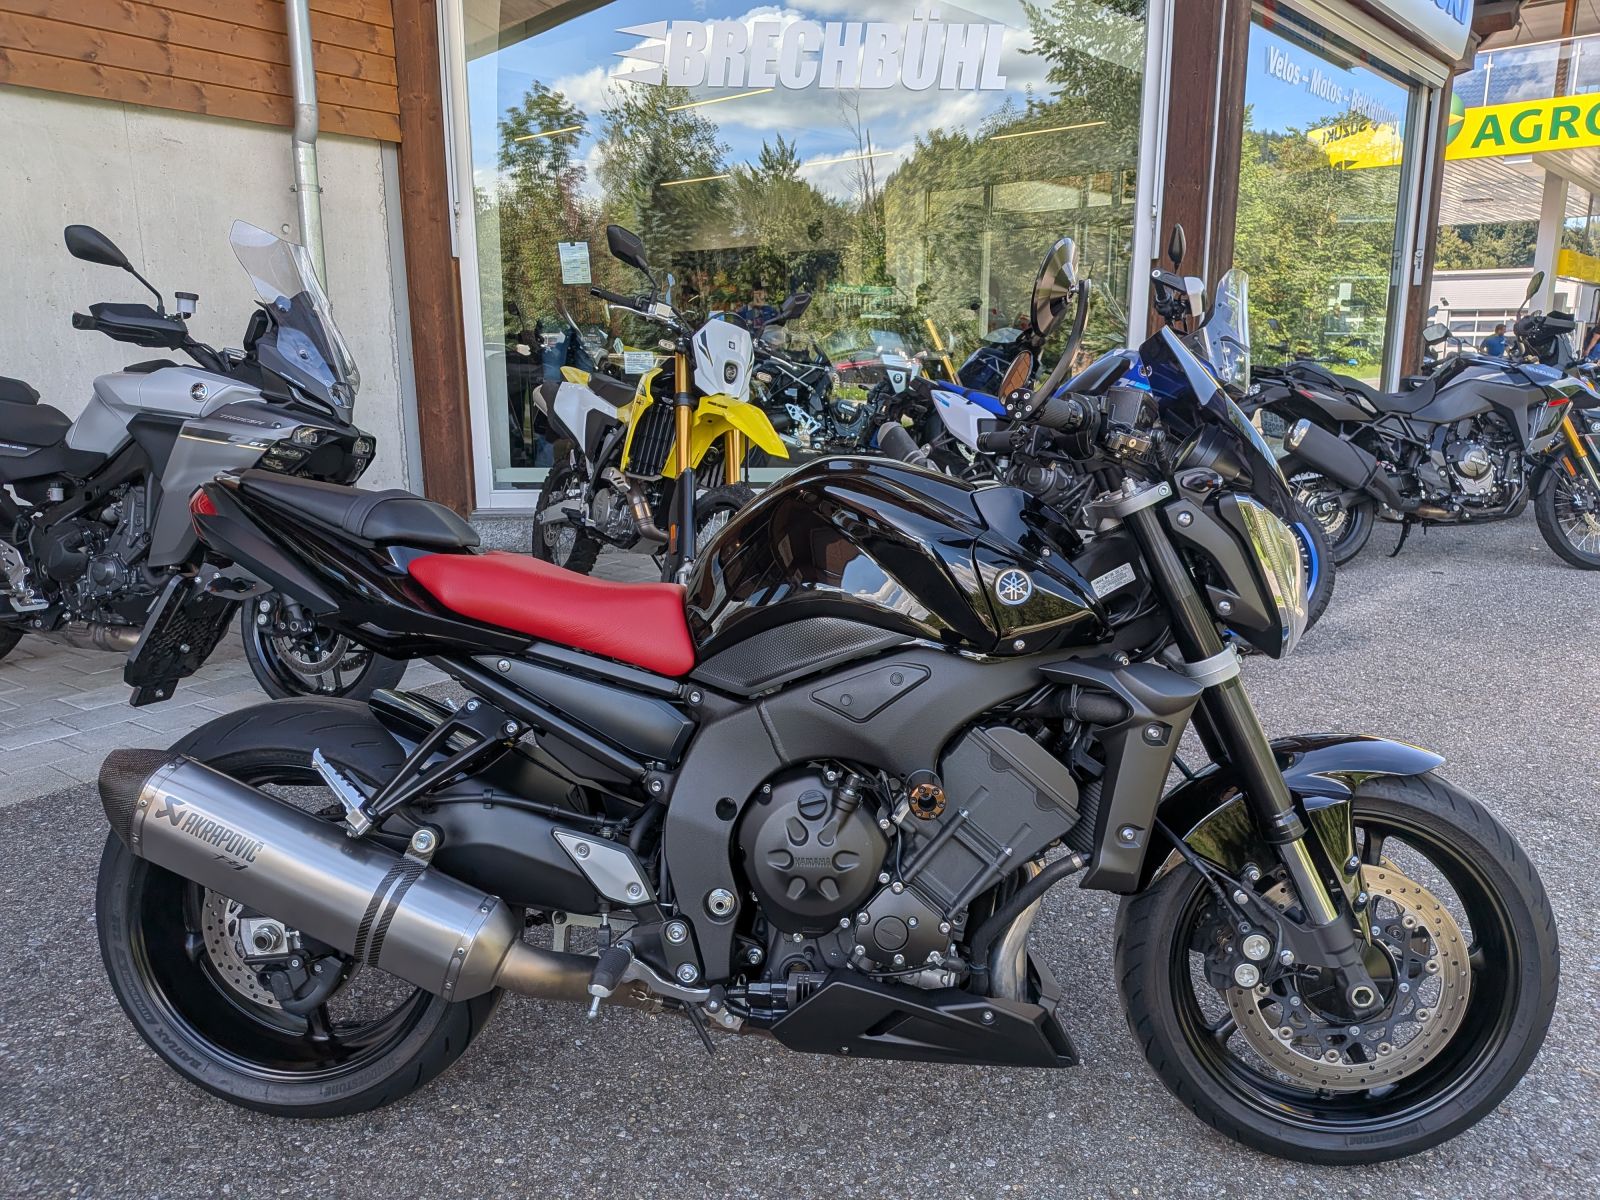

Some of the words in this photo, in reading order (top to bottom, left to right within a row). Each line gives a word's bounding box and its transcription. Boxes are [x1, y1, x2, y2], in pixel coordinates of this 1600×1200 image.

[667, 9, 1008, 91] BRECHBÜHL
[1269, 45, 1301, 86] Velos
[1310, 67, 1343, 105] Motos
[794, 856, 832, 869] YAMAHA
